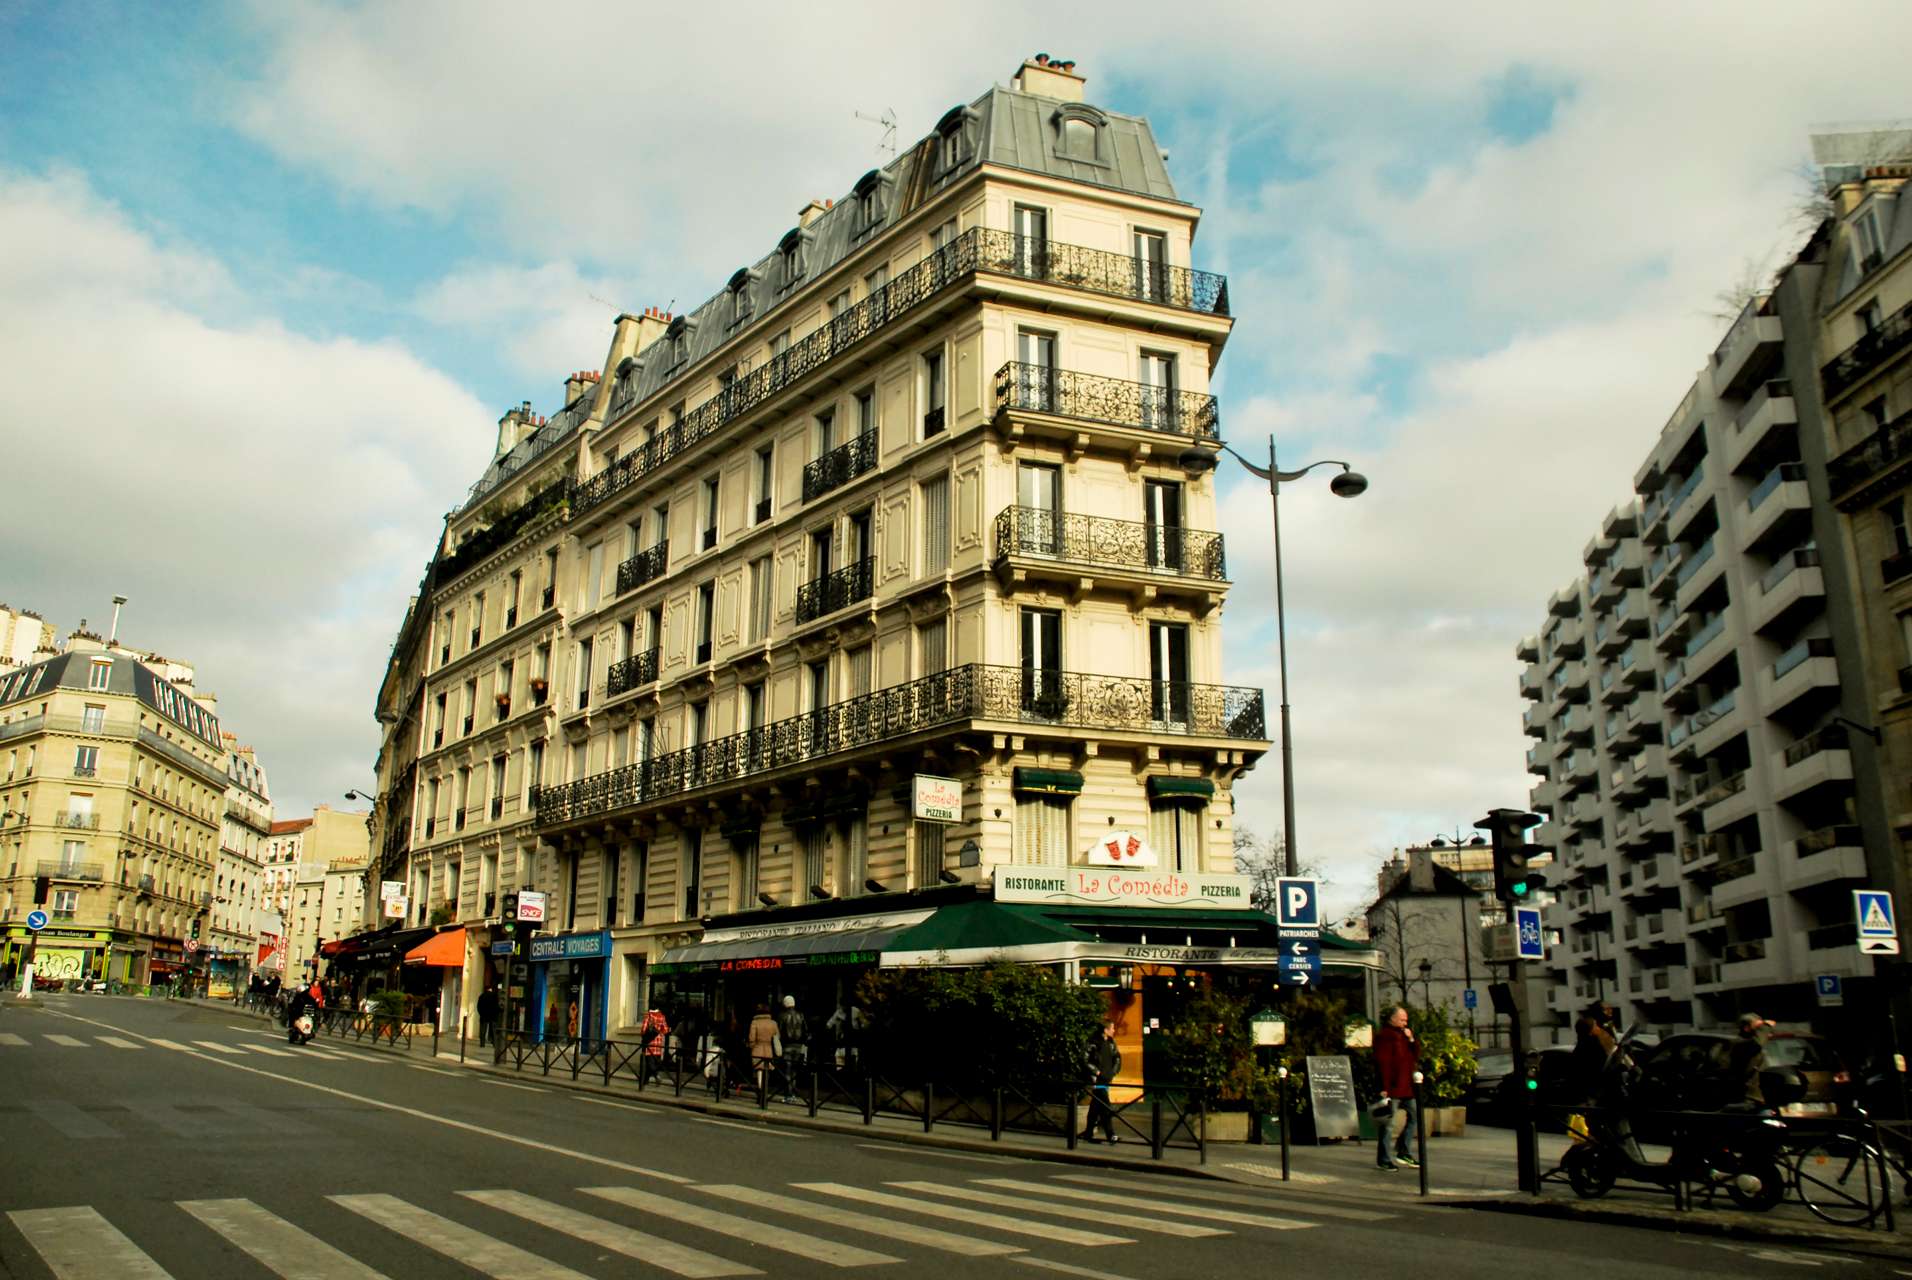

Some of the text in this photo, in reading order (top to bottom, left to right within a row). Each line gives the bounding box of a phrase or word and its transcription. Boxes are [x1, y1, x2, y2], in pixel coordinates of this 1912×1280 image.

[925, 808, 953, 819] PIZZERIA
[1005, 873, 1241, 898] RISTORANTE La Comédia PIZZERIA
[1287, 886, 1308, 918] P
[521, 909, 542, 918] SNCF
[1279, 929, 1320, 938] PATRIARCHES
[532, 940, 565, 957] CENTRALE
[567, 938, 600, 953] VOYAGES
[1125, 946, 1220, 960] RISTORANTE
